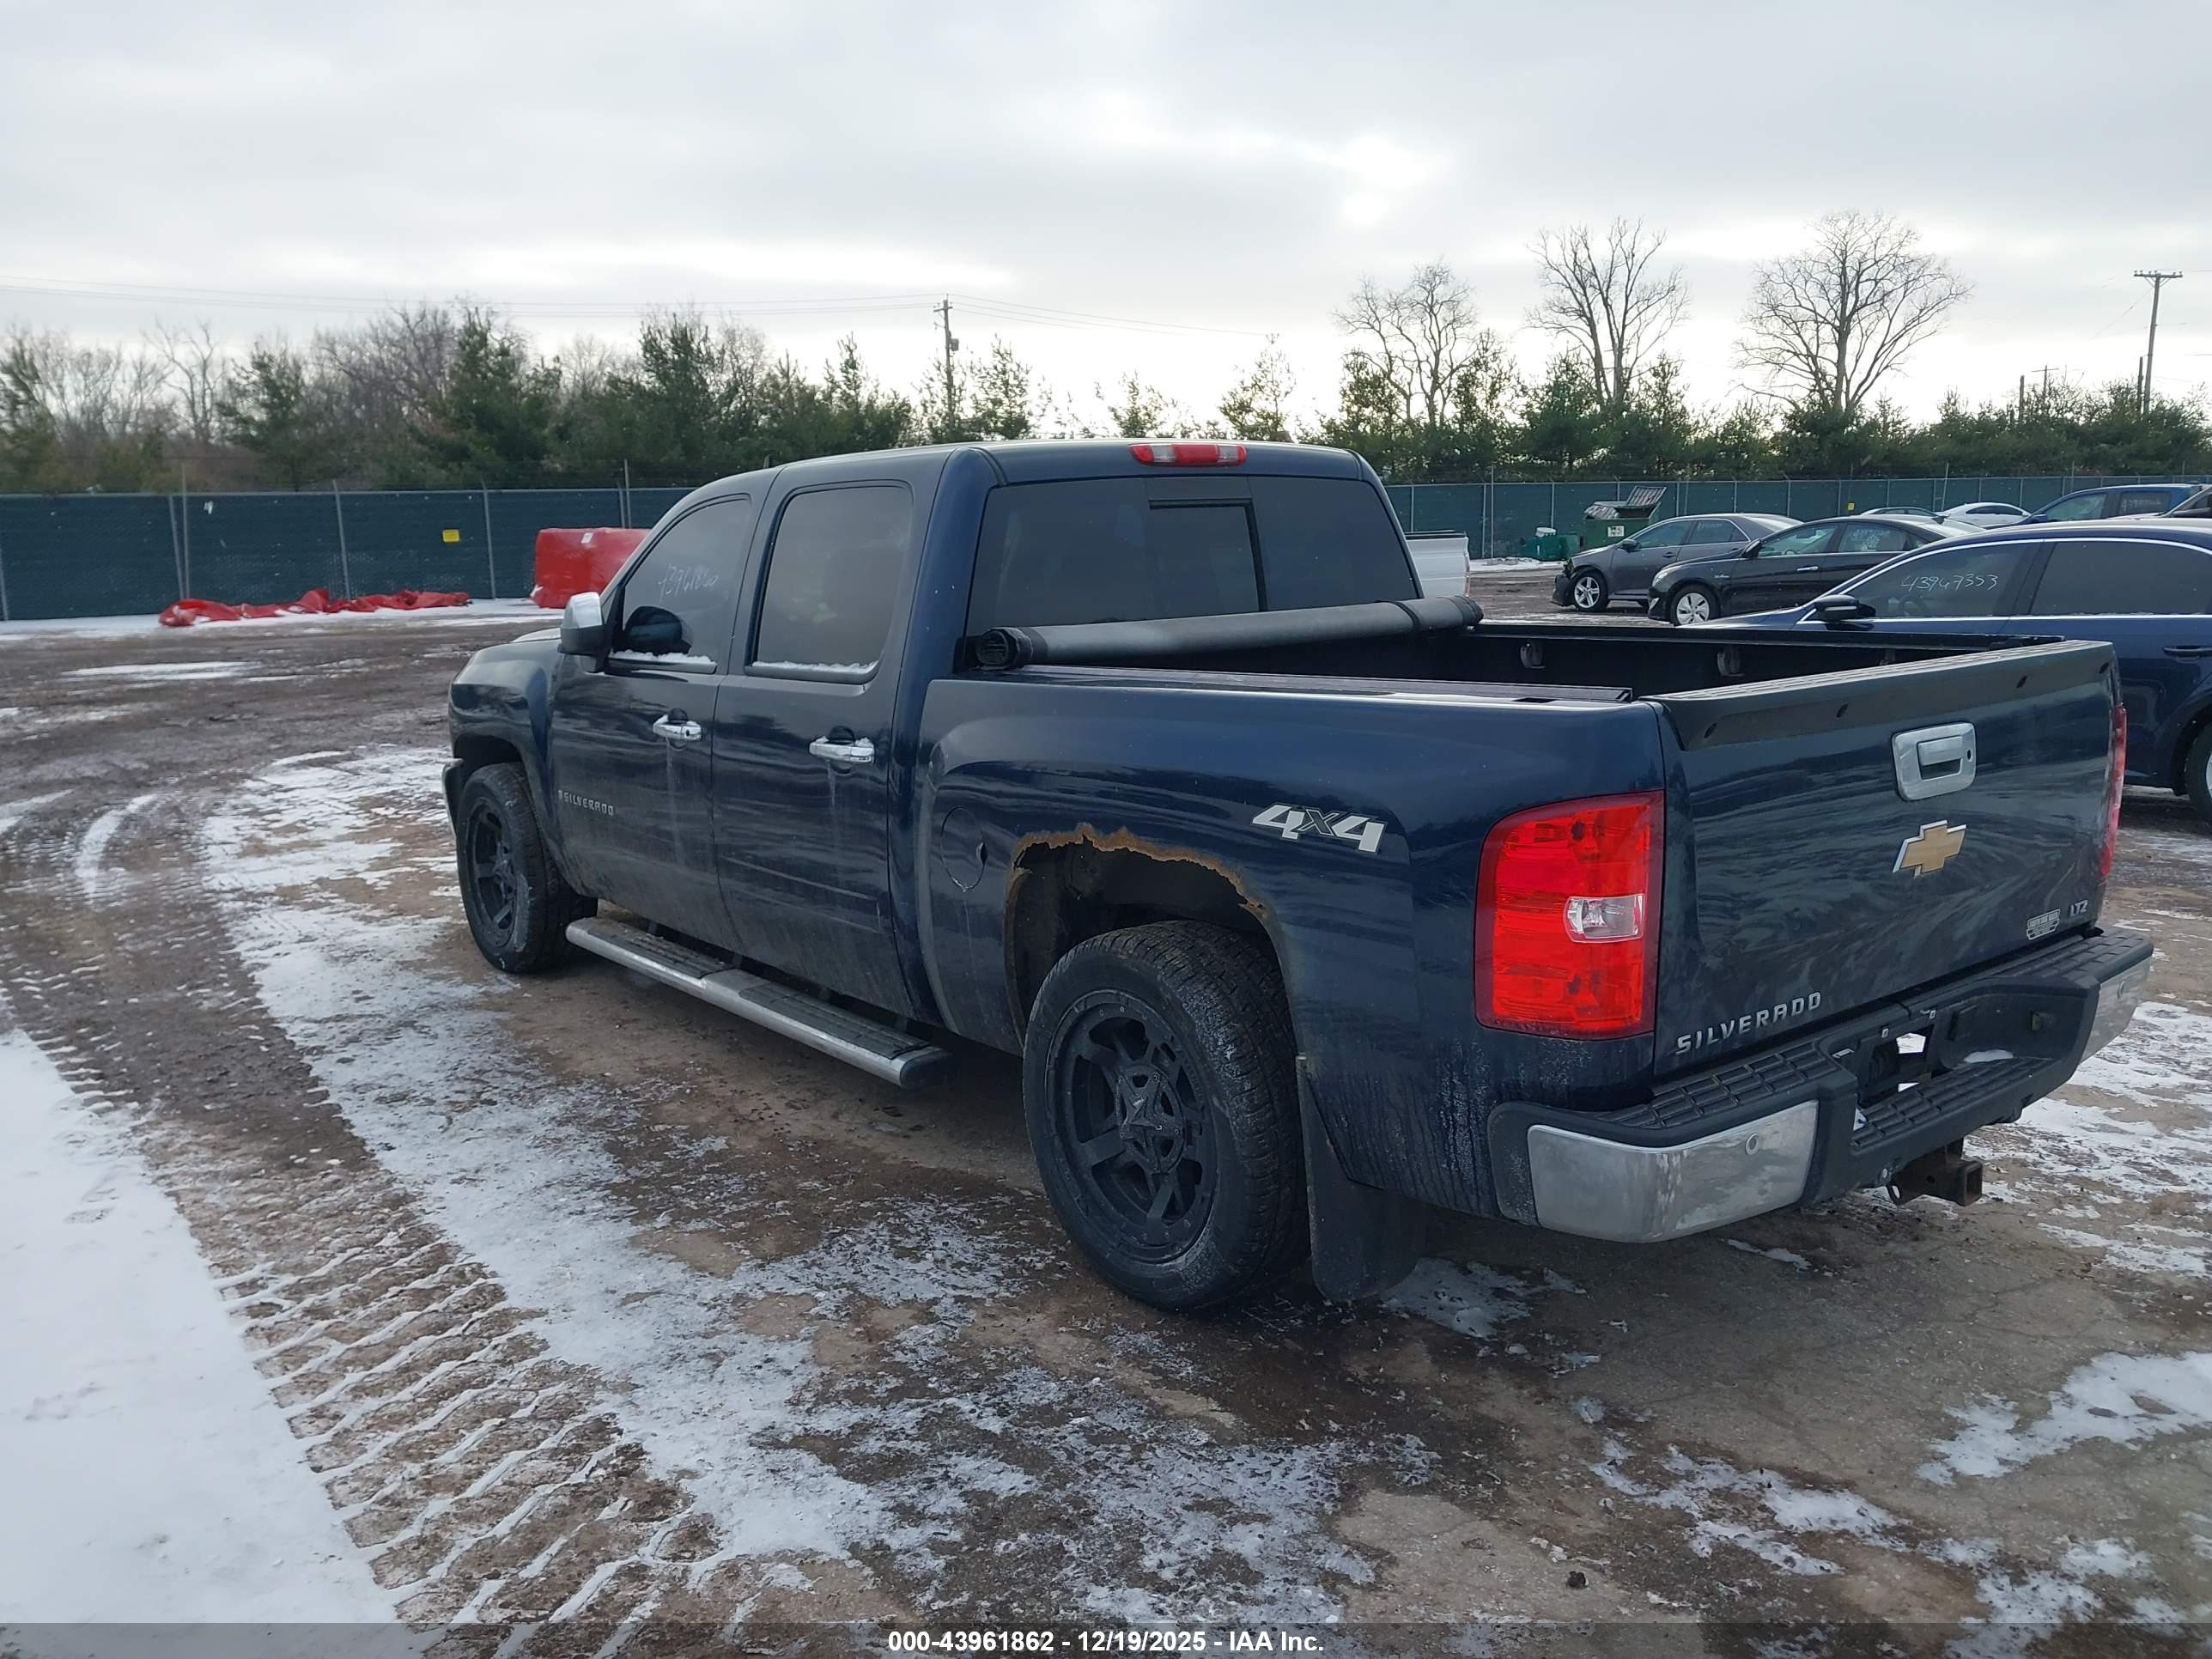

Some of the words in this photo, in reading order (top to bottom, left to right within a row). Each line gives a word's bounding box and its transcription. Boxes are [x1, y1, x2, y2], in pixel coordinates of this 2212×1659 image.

[563, 792, 614, 816] SILVERADO
[2069, 899, 2088, 917] LTZ
[1675, 991, 1821, 1056] SILVERADO
